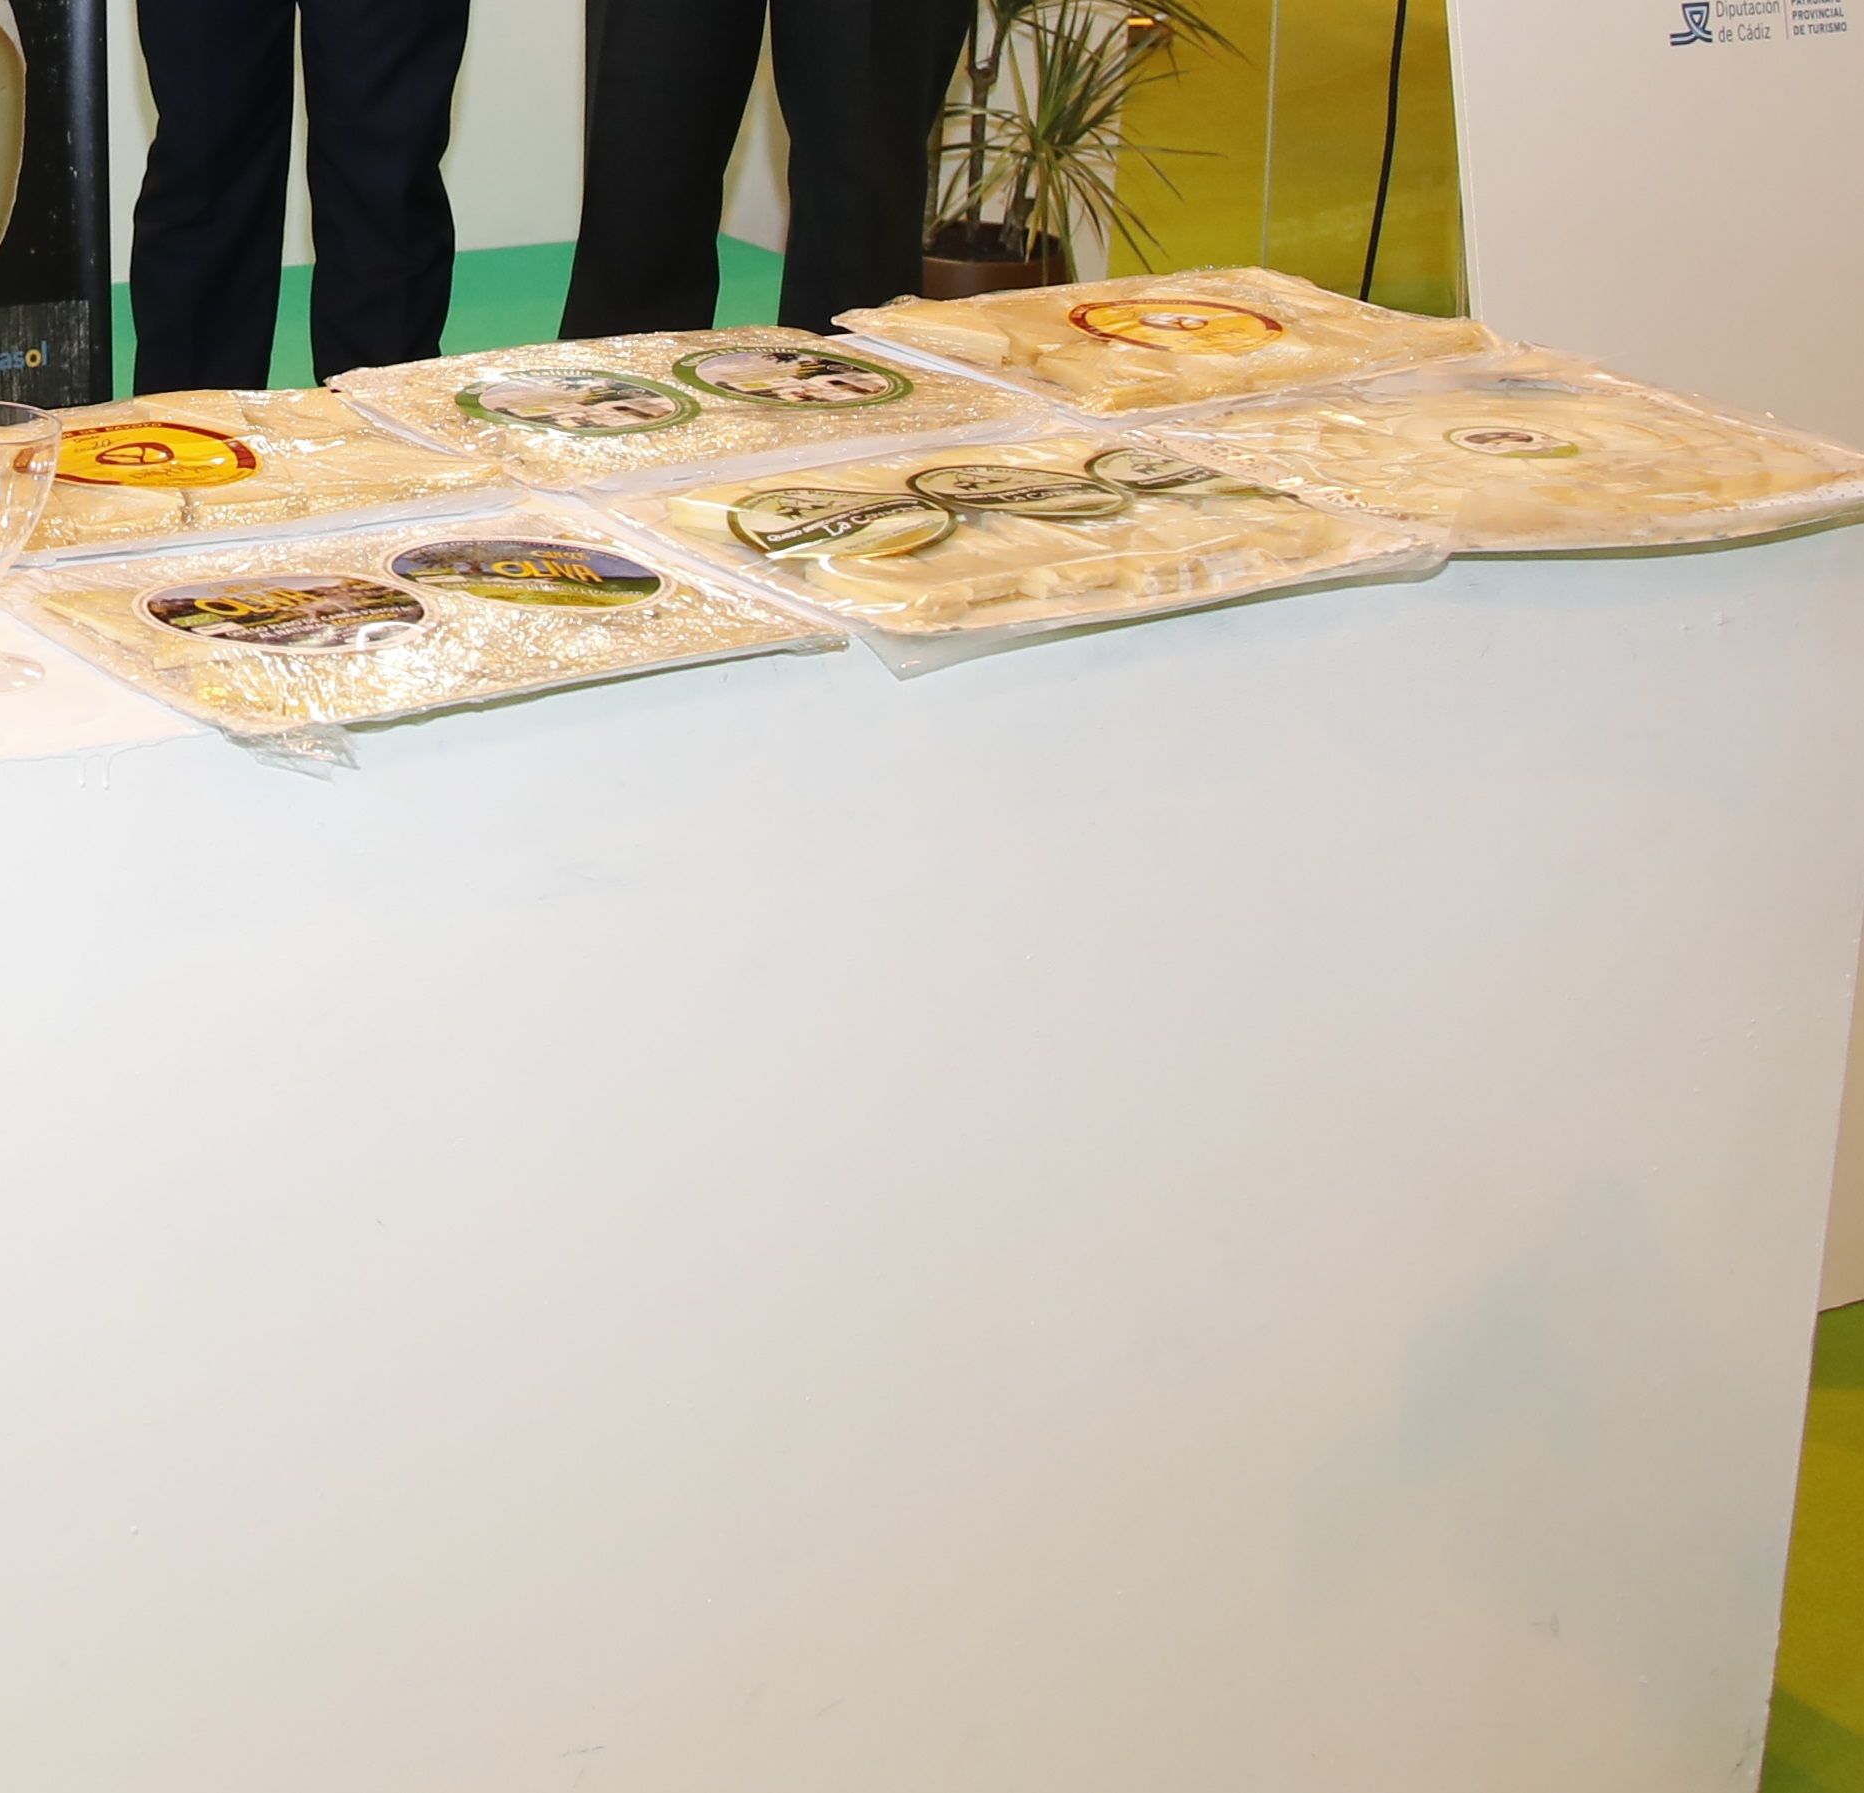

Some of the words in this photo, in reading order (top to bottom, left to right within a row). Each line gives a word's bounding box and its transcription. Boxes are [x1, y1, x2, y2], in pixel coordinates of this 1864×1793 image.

[1718, 26, 1734, 43] de
[1737, 21, 1771, 42] Cádiz
[1792, 6, 1845, 21] PROVINCIAL
[1793, 24, 1804, 36] DE
[1808, 21, 1848, 34] TURISMO
[491, 559, 604, 584] OLIVA
